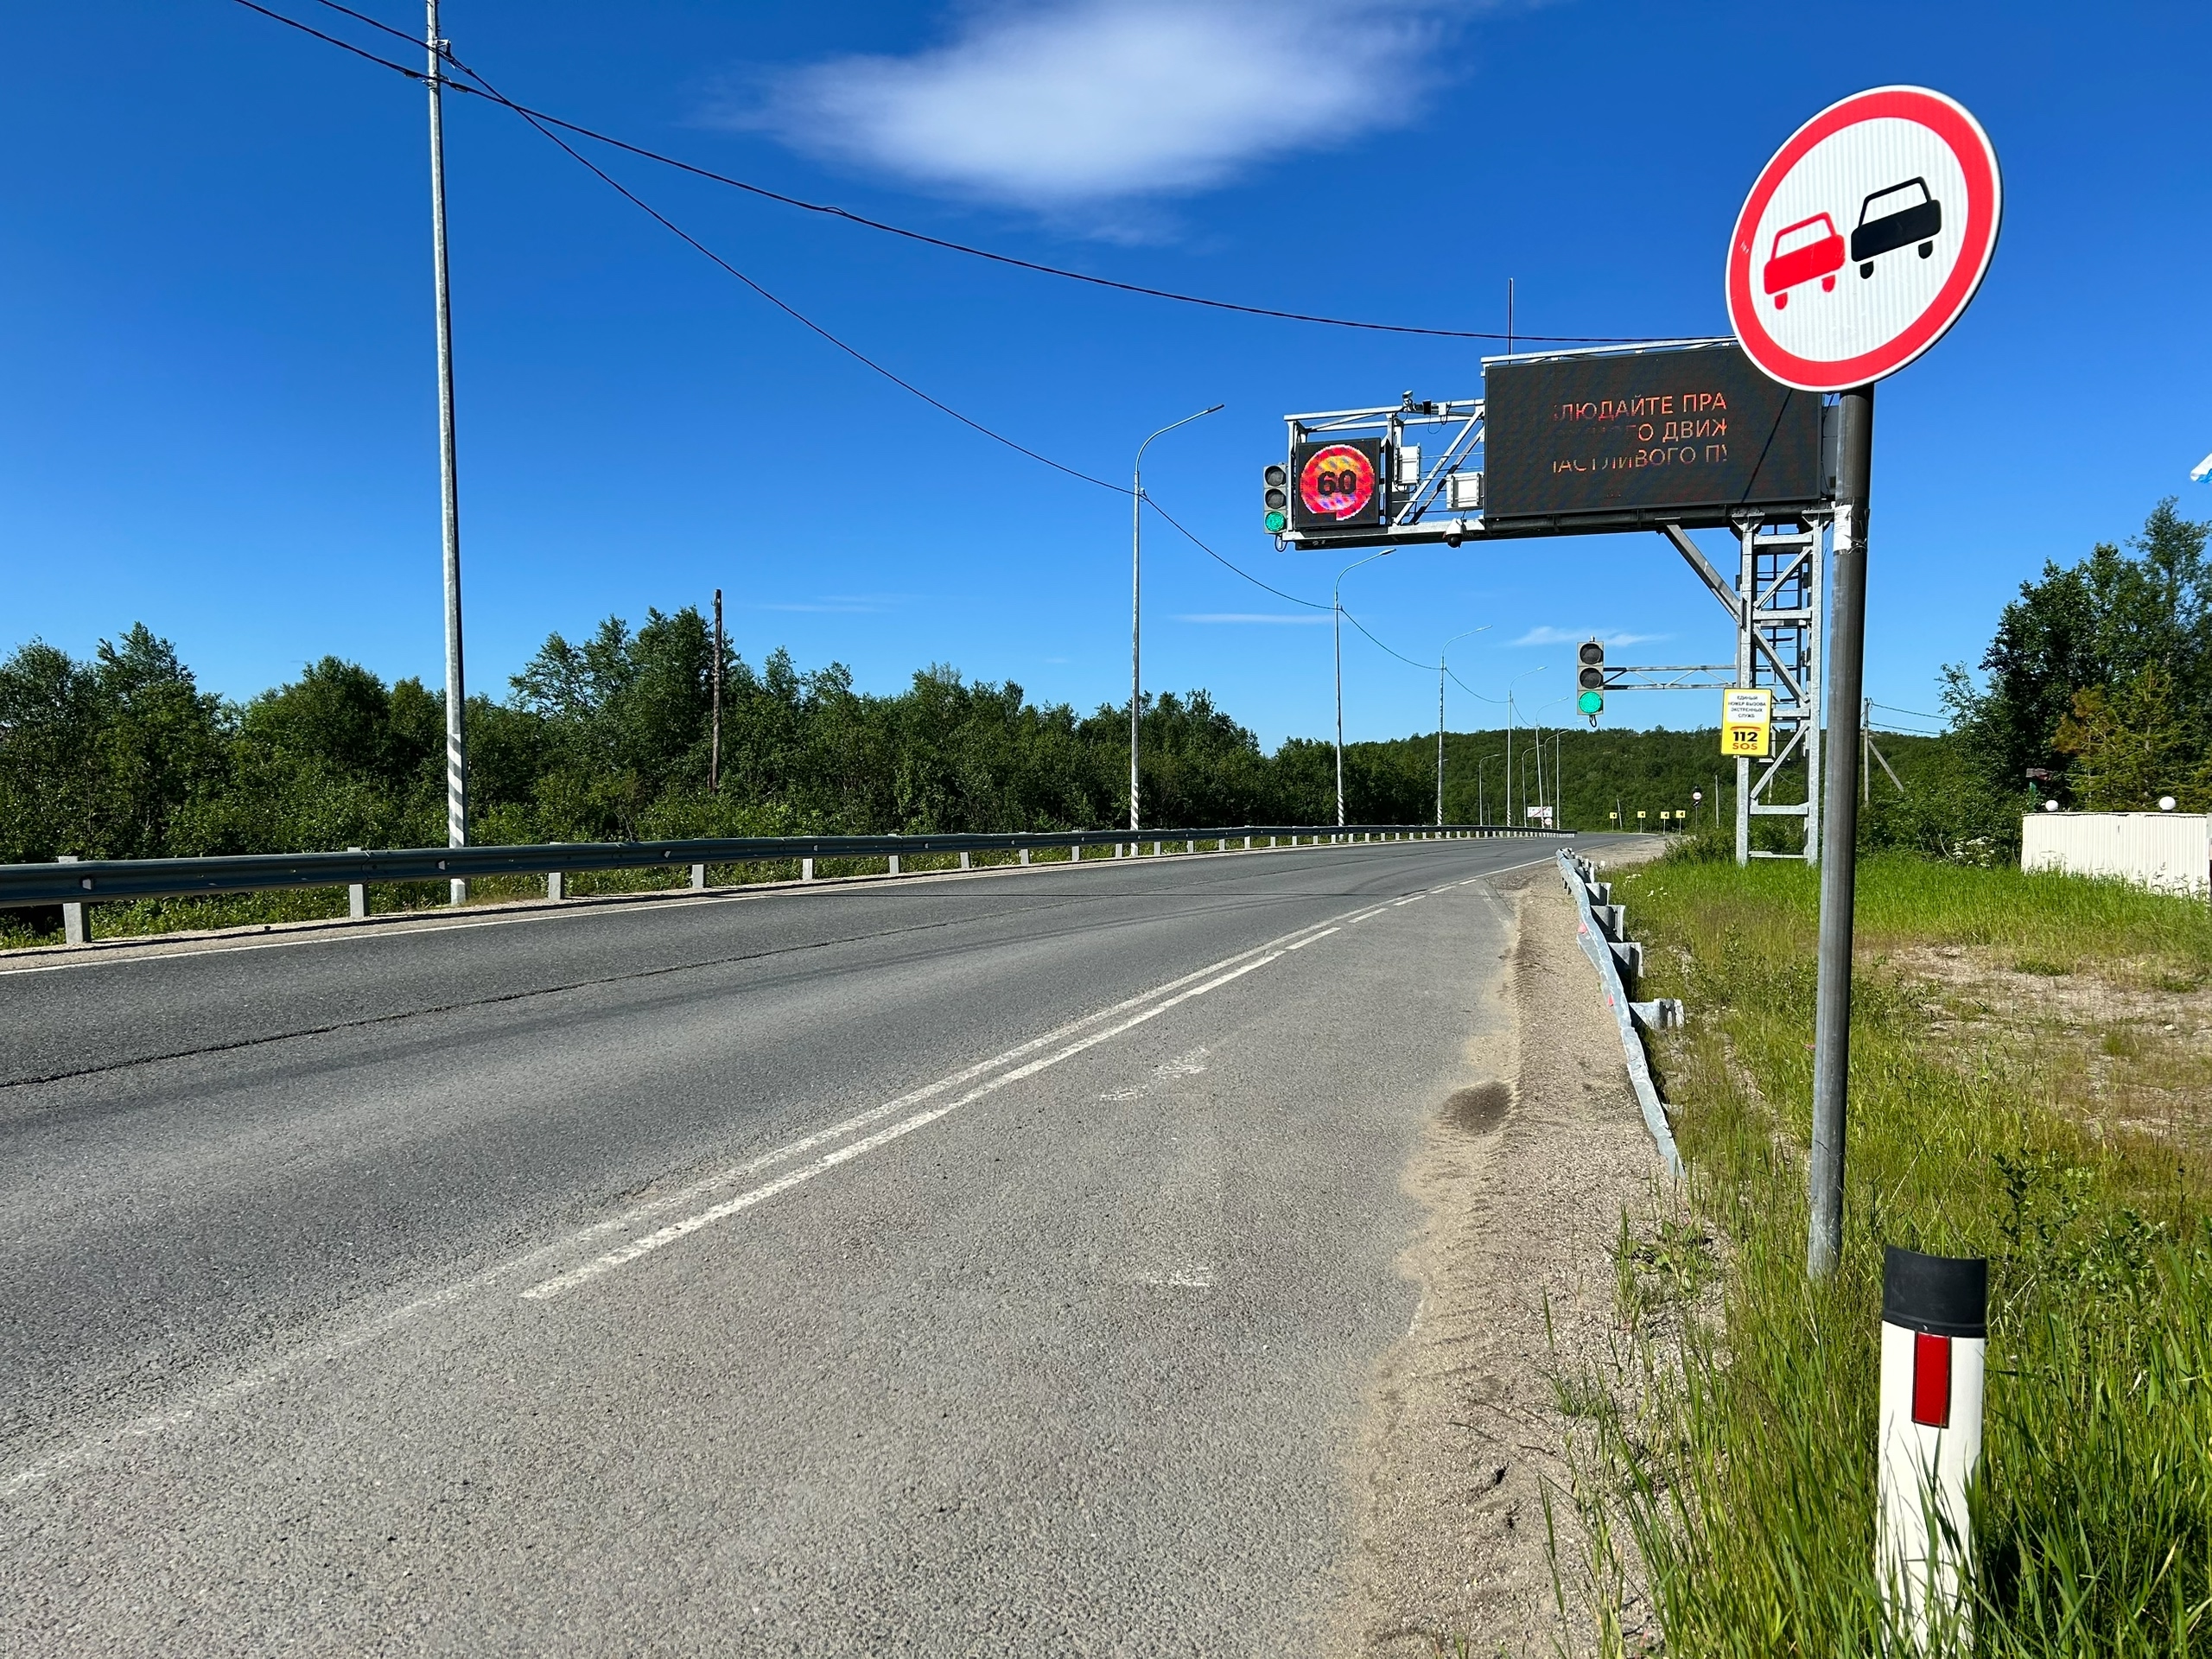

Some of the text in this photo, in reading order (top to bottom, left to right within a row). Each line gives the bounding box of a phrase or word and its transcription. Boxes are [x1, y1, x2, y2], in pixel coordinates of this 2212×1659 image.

[1683, 392, 1727, 413] ПРА
[1662, 418, 1728, 443] ДВИЖ
[1317, 469, 1357, 496] 60
[1733, 731, 1758, 741] 112
